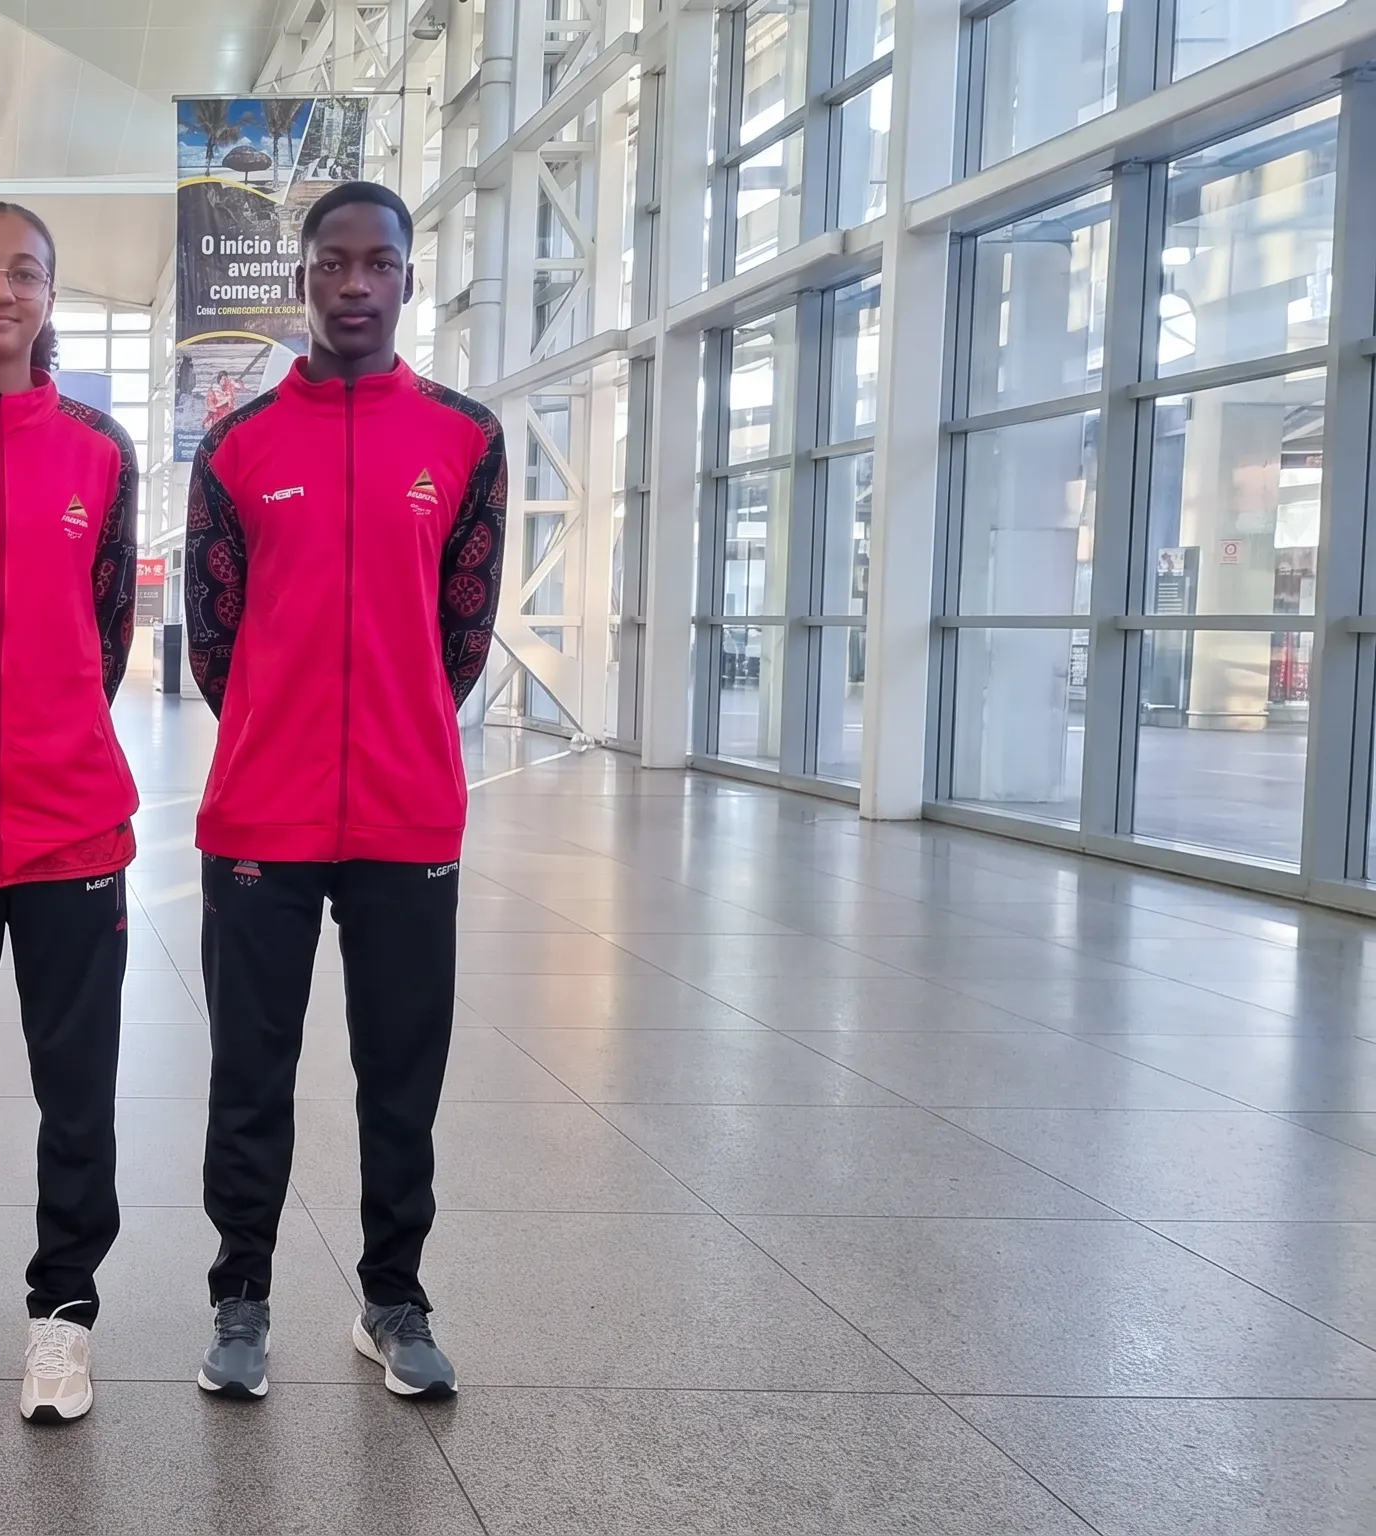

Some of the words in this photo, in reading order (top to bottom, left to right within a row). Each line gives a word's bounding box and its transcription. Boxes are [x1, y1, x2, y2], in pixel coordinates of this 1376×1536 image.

[201, 235, 215, 255] O
[220, 235, 271, 255] início
[276, 235, 299, 255] da
[228, 260, 301, 277] aventur
[210, 284, 282, 304] começa
